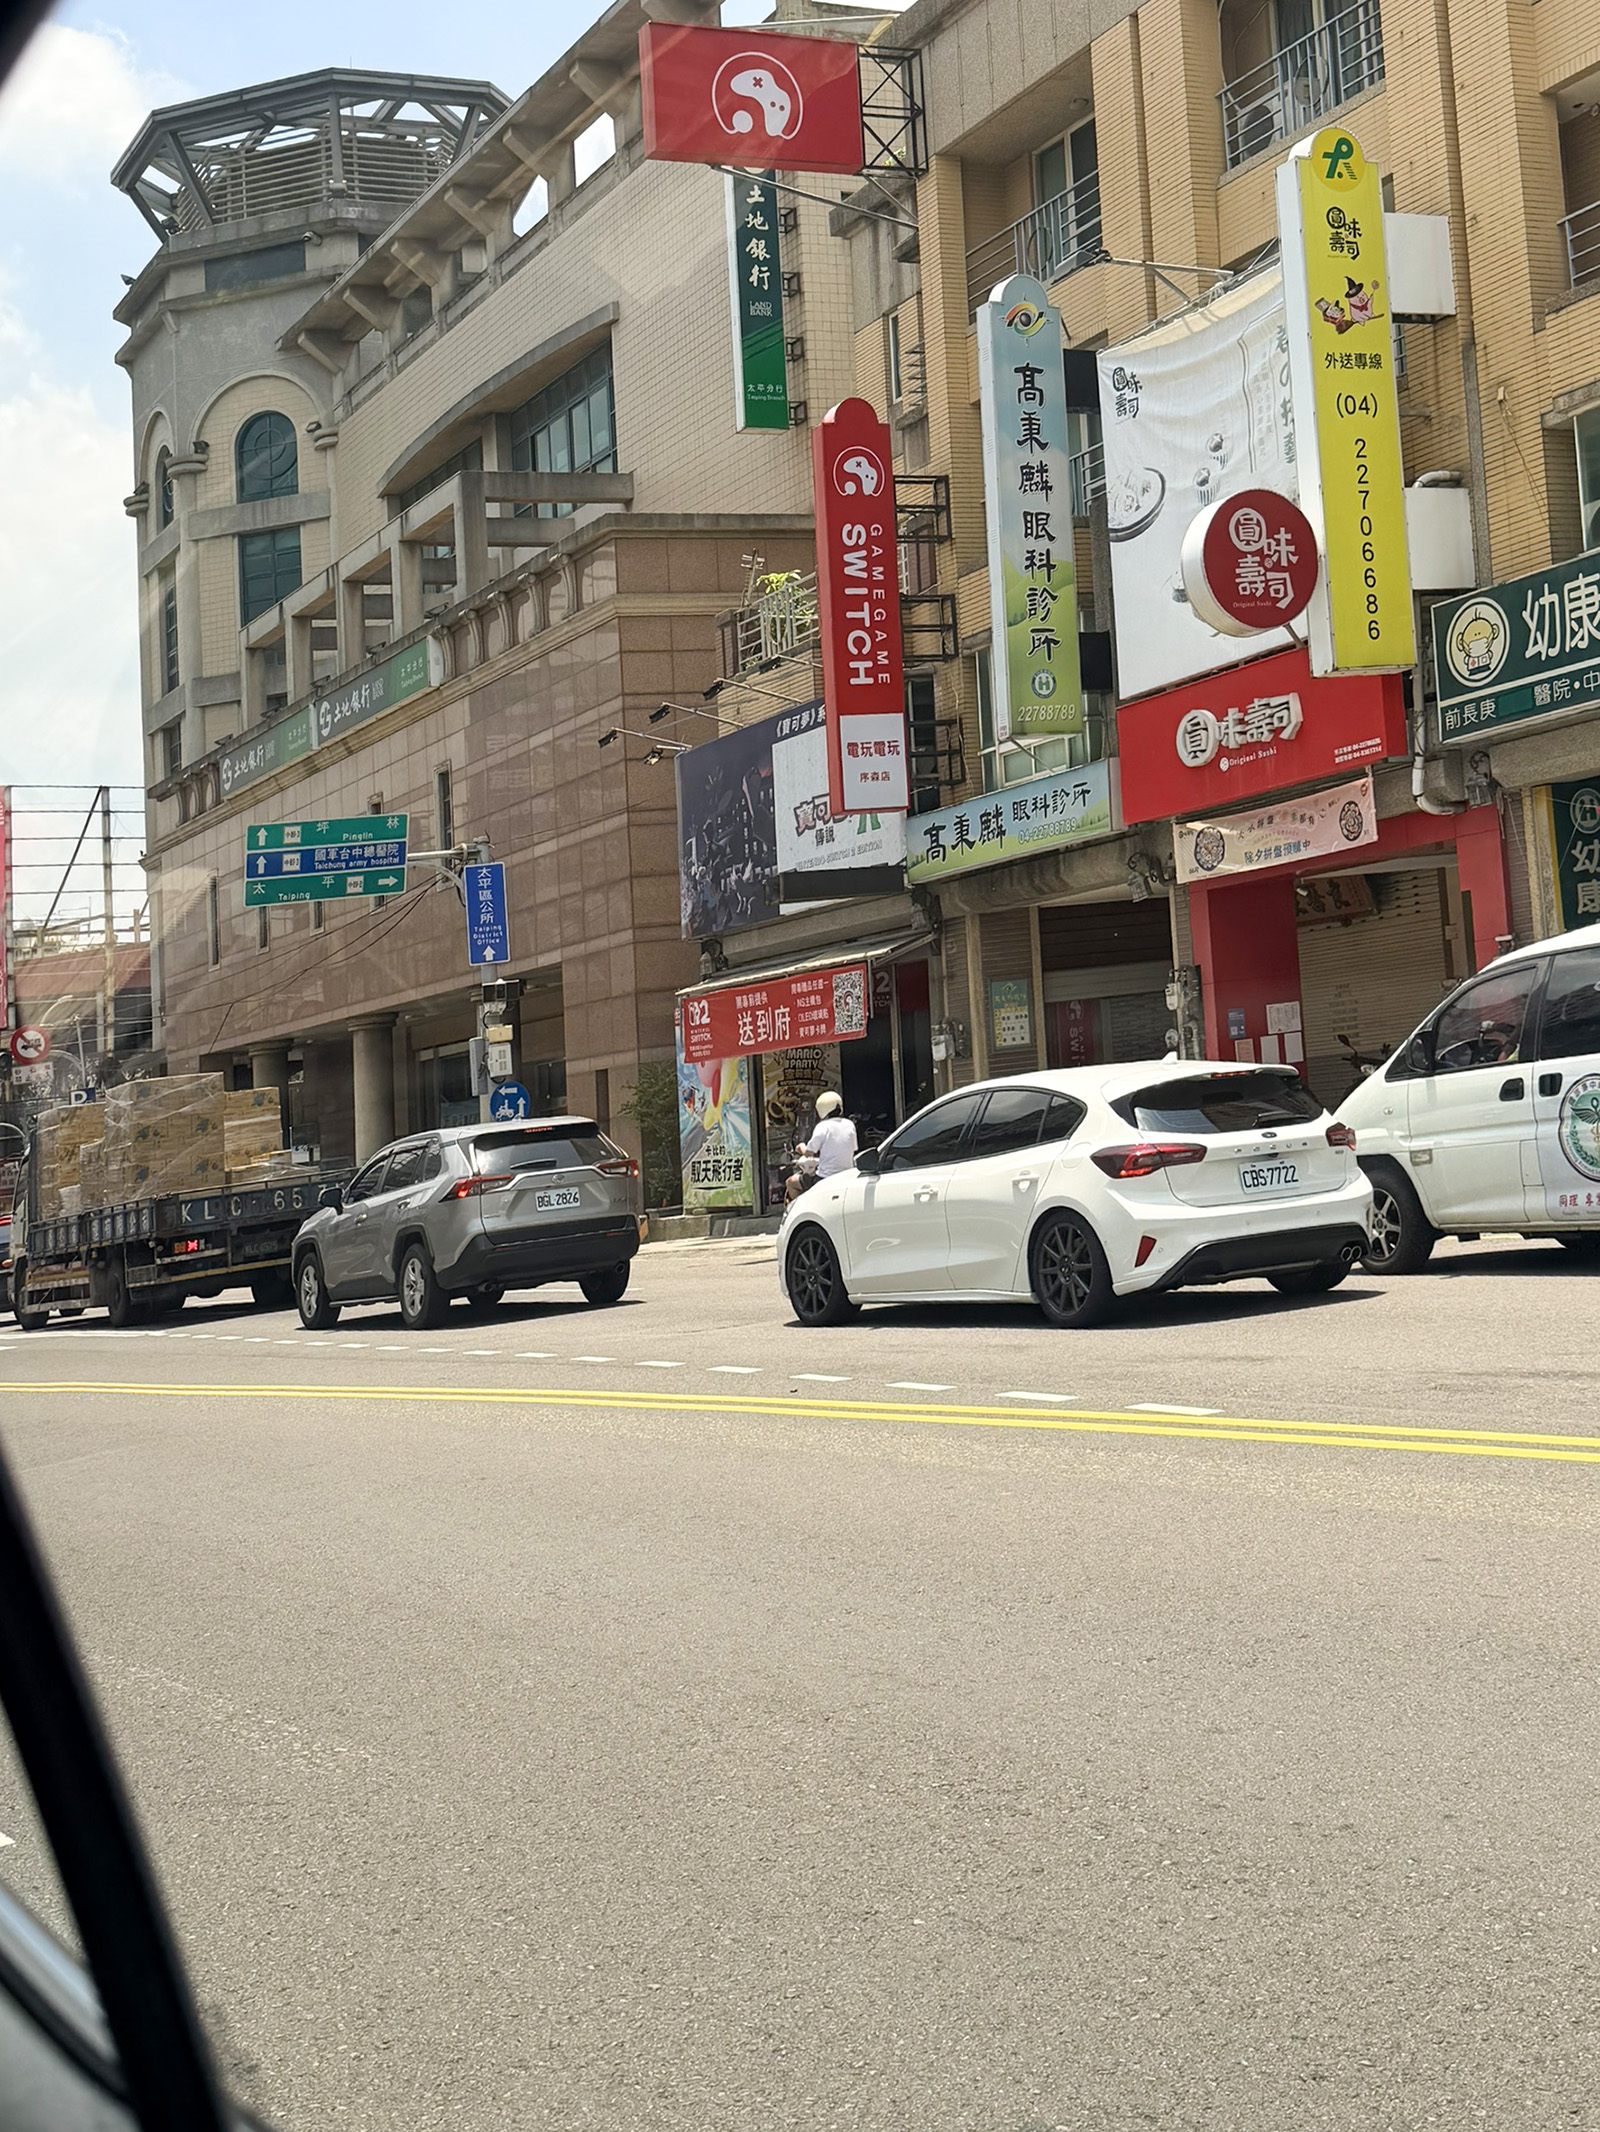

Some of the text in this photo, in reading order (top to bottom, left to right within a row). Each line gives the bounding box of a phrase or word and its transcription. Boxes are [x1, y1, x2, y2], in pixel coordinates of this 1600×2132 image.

[744, 184, 772, 291] 土地銀行
[750, 300, 772, 310] LAND
[750, 308, 773, 317] BANK
[1325, 352, 1383, 370] 外送專線
[1336, 393, 1378, 418] (04)
[842, 523, 874, 685] SWITCH
[334, 683, 370, 723] 土地銀行
[1018, 703, 1075, 722] 22788789
[1445, 699, 1496, 731] 前長庚
[1176, 692, 1303, 768] 圓味壽司
[847, 741, 900, 758] 電玩電玩
[1229, 746, 1277, 766] Original Sushi
[860, 771, 890, 783] 序森店
[1012, 781, 1091, 822] 眼科診所
[342, 833, 373, 843] Pinglin
[815, 826, 835, 847] 傳說
[1018, 817, 1078, 845] 04-22788789
[314, 843, 400, 862] 國軍台中總醫院
[314, 856, 400, 871] Taichung army hospital
[278, 891, 311, 902] Taiping
[477, 867, 494, 924] 太平區公所
[473, 931, 503, 939] District
[738, 1005, 791, 1046] 送到府
[787, 1048, 822, 1059] MARIO
[790, 1059, 819, 1069] PARTY
[1242, 1165, 1299, 1189] CBS-7722
[537, 1191, 579, 1208] BGL-2826
